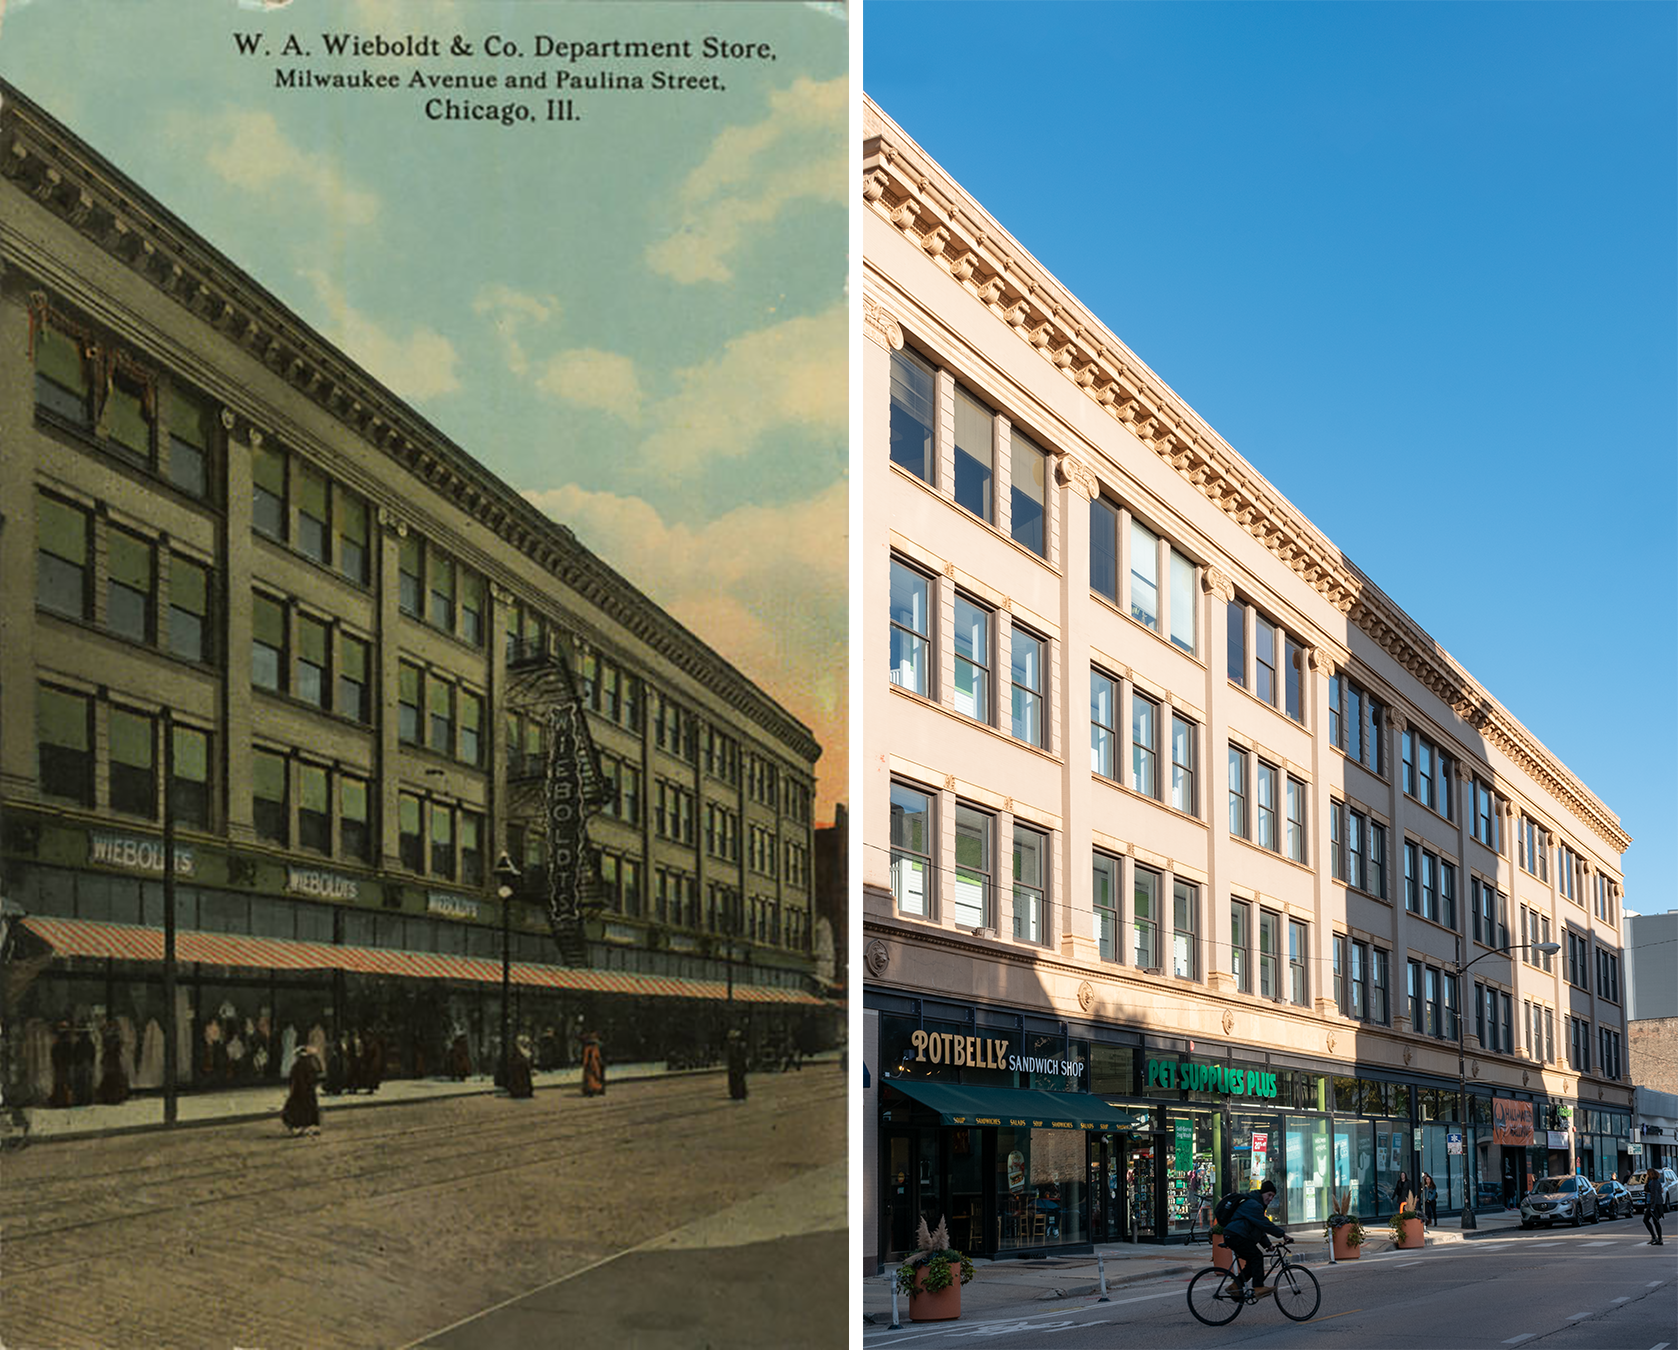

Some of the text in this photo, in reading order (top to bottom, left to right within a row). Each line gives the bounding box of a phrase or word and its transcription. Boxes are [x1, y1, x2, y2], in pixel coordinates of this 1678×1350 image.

[552, 715, 573, 911] WIEBOLDTS
[92, 837, 193, 873] WIEBOLTS
[911, 1029, 1085, 1078] POTBELLY SANDWICH SHOP
[1148, 1058, 1278, 1098] PET SUPPLIES PLUS
[1009, 1119, 1026, 1127] SALADS
